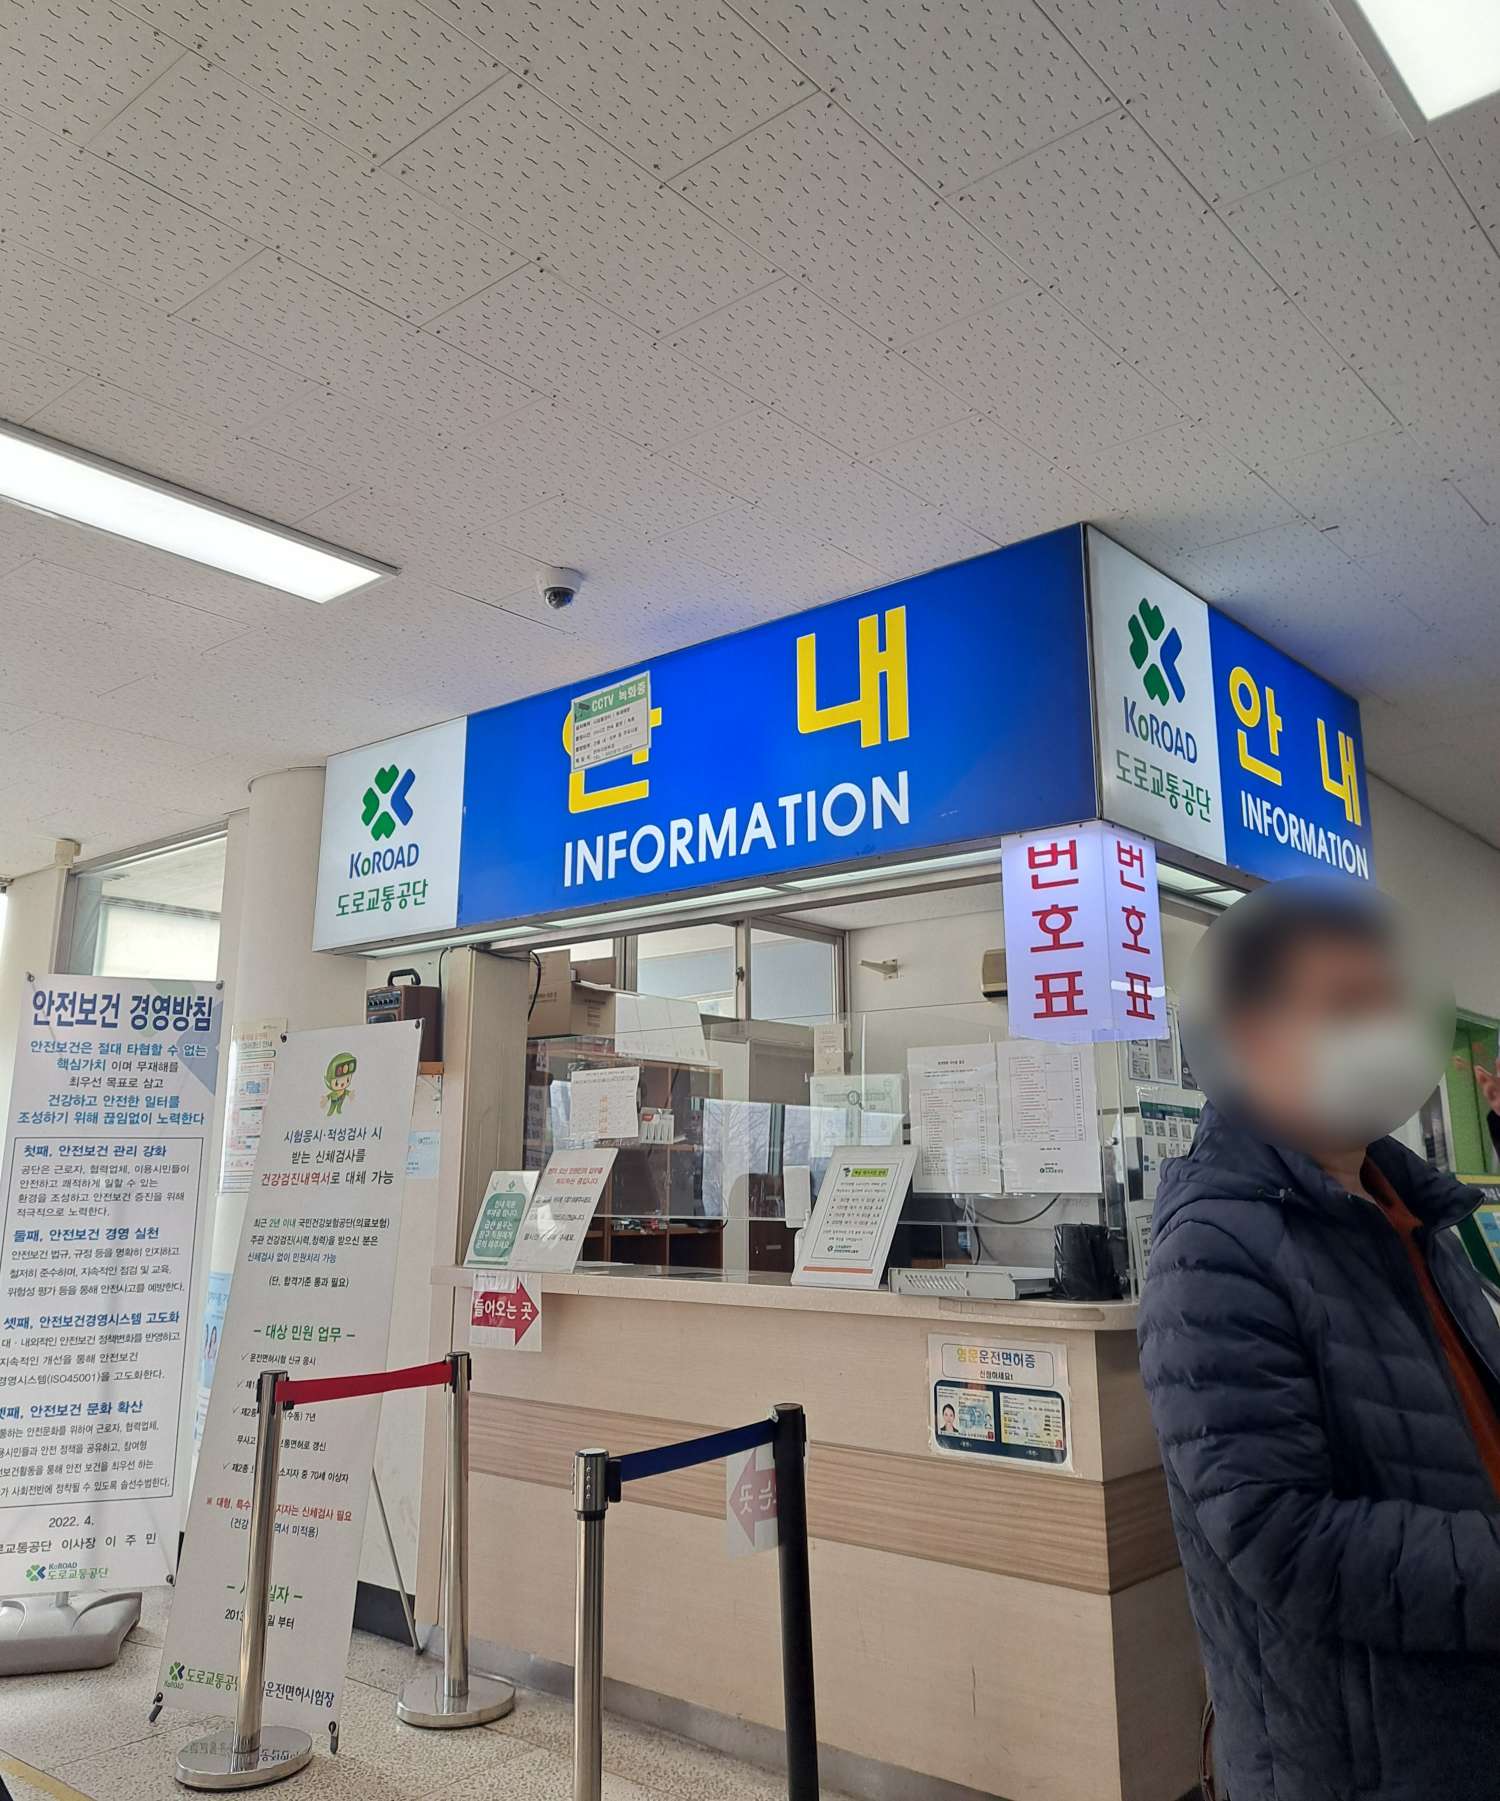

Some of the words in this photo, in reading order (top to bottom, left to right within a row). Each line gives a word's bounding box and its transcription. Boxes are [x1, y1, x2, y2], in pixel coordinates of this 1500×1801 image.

[797, 606, 910, 748] 내
[592, 694, 615, 712] CCTV
[1123, 696, 1198, 765] KoROAD
[1229, 666, 1283, 787] 안
[1317, 718, 1361, 827] 내
[1115, 749, 1212, 824] 도로교통공단
[564, 771, 911, 887] INFORMATION
[1240, 789, 1369, 880] INFORMATION
[349, 842, 420, 879] KoROAD
[336, 879, 429, 917] 도로교통공단
[1027, 839, 1089, 1021] 번호표
[1115, 840, 1156, 1022] 번호표
[32, 990, 121, 1028] 안전보건
[130, 994, 214, 1032] 경영방침
[30, 1041, 93, 1055] 안전보건은
[98, 1042, 121, 1056] 절대
[126, 1043, 163, 1057] 타협할
[167, 1044, 178, 1057] 수
[184, 1045, 207, 1057] 없는
[56, 1058, 107, 1072] 핵심가치
[111, 1061, 133, 1073] 이며
[69, 1076, 102, 1088] 최우선
[106, 1077, 138, 1089] 목표로
[143, 1077, 164, 1089] 삼고
[48, 1094, 98, 1107] 건강하고
[103, 1095, 139, 1108] 안전한
[144, 1095, 180, 1109] 일터를
[17, 1111, 68, 1124] 조성하기
[74, 1112, 99, 1124] 위해
[103, 1112, 153, 1125] 끊임없이
[156, 1112, 205, 1125] 노력한다
[371, 1126, 383, 1140] 시
[24, 1145, 52, 1157] 첫째,
[58, 1145, 109, 1157] 안전보건
[113, 1145, 137, 1157] 관리
[143, 1145, 167, 1157] 강화
[291, 1150, 310, 1164] 받는
[315, 1148, 366, 1164] 신체검사를
[21, 1164, 51, 1174] 공단은
[134, 1164, 190, 1174] 이용시민들이
[19, 1179, 58, 1189] 안전하고
[104, 1178, 123, 1188] 일할
[127, 1178, 137, 1188] 수
[140, 1178, 158, 1188] 있는
[261, 1171, 340, 1187] 건강검진내역서로
[345, 1171, 366, 1185] 대체
[371, 1170, 395, 1185] 가능
[18, 1193, 47, 1204] 환경을
[51, 1193, 90, 1203] 조성하고
[93, 1192, 131, 1202] 안전보건
[135, 1192, 163, 1202] 증진을
[166, 1191, 185, 1201] 위해
[16, 1207, 65, 1217] 적극적으로
[68, 1207, 110, 1217] 노력한다.
[253, 1218, 267, 1228] 최근
[269, 1218, 280, 1228] 2년
[282, 1218, 296, 1228] 이내
[13, 1229, 43, 1243] 둘째,
[49, 1228, 100, 1242] 안전보건
[105, 1228, 130, 1240] 경영
[134, 1227, 160, 1240] 실천
[337, 1236, 359, 1246] 받으신
[362, 1236, 379, 1246] 분은
[11, 1250, 48, 1260] 안전보건
[73, 1249, 93, 1259] 규정
[95, 1249, 113, 1258] 등을
[116, 1248, 143, 1258] 명확히
[145, 1247, 180, 1257] 인지하고
[247, 1252, 275, 1262] 신체검사
[276, 1252, 290, 1262] 없이
[292, 1252, 320, 1263] 민원처리
[322, 1253, 337, 1264] 가능
[9, 1268, 38, 1279] 철저히
[81, 1266, 118, 1277] 지속적인
[120, 1266, 138, 1276] 점검
[140, 1265, 149, 1275] 및
[8, 1287, 35, 1297] 위험성
[38, 1287, 56, 1297] 평가
[59, 1286, 77, 1296] 등을
[80, 1286, 98, 1295] 통해
[100, 1284, 145, 1295] 안전사고를
[147, 1282, 185, 1293] 예방한다.
[284, 1276, 311, 1287] 합격기준
[314, 1277, 328, 1287] 통과
[331, 1277, 349, 1288] 필요)
[474, 1298, 517, 1320] 들어오는
[521, 1301, 533, 1321] 곳
[3, 1317, 33, 1330] 셋째,
[39, 1313, 142, 1329] 안전보건경영시스템
[146, 1311, 181, 1324] 고도화
[20, 1337, 57, 1348] 내외적인
[59, 1335, 96, 1346] 안전보건
[145, 1332, 181, 1343] 반영하고
[265, 1324, 288, 1340] 대상
[291, 1325, 313, 1341] 민원
[318, 1326, 342, 1342] 업무
[43, 1355, 72, 1365] 개선을
[76, 1354, 96, 1364] 통해
[99, 1352, 139, 1363] 안전보건
[249, 1353, 286, 1364] 운전면허시험
[289, 1354, 301, 1364] 신규
[303, 1355, 317, 1366] 응시
[113, 1369, 165, 1381] 고도화한다.
[30, 1403, 82, 1418] 안전보건
[87, 1401, 113, 1416] 문화
[118, 1399, 144, 1413] 확산
[305, 1412, 316, 1423] 7년
[26, 1425, 66, 1438] 안전문화를
[70, 1424, 94, 1435] 위하여
[40, 1446, 57, 1456] 안전
[60, 1444, 83, 1455] 정책을
[312, 1441, 327, 1452] 갱신
[46, 1464, 63, 1474] 통해
[66, 1463, 82, 1474] 안전
[111, 1460, 135, 1471] 최우선
[138, 1459, 154, 1470] 하는
[301, 1469, 308, 1479] 중
[328, 1472, 349, 1483] 이상자
[11, 1485, 53, 1497] 사회전반에
[82, 1482, 91, 1493] 수
[94, 1480, 117, 1492] 있도록
[236, 1498, 251, 1511] 특수
[302, 1507, 334, 1521] 신체검사
[336, 1510, 352, 1522] 필요
[48, 1517, 79, 1529] 2022.
[84, 1515, 95, 1527] 4.
[292, 1525, 319, 1538] 미적용)
[61, 1537, 96, 1551] 이사장
[105, 1536, 116, 1548] 이
[125, 1534, 137, 1546] 주
[145, 1532, 156, 1545] 민
[48, 1567, 108, 1580] 도로교통공단
[277, 1616, 295, 1630] 부터
